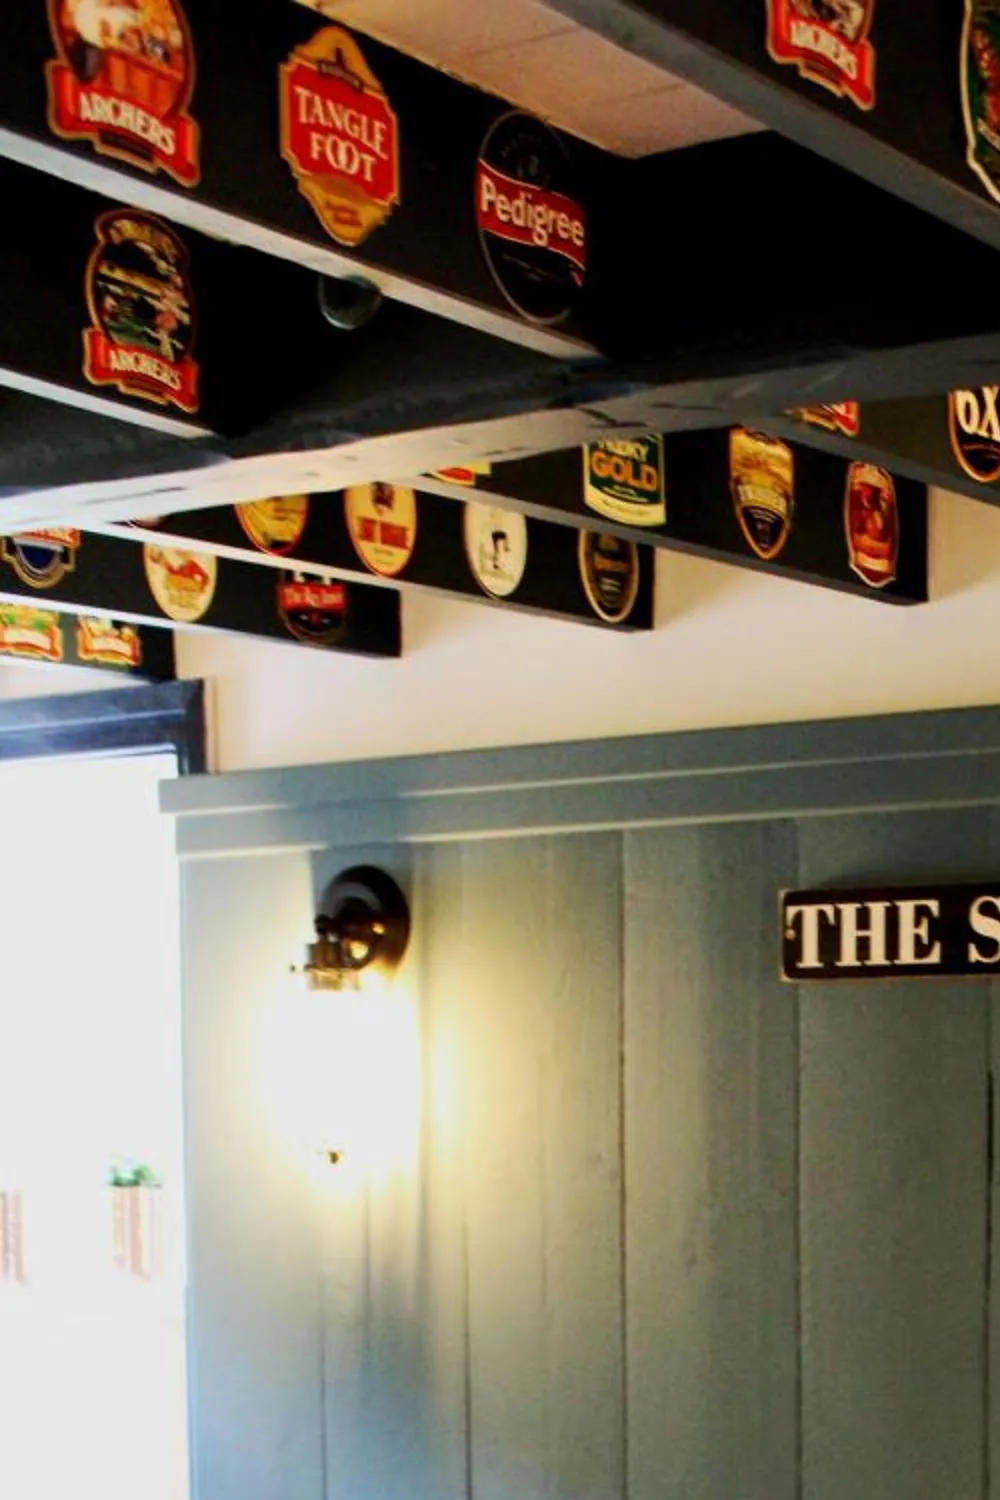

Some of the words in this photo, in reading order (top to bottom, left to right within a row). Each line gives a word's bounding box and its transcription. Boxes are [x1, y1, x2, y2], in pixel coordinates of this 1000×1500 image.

[79, 91, 176, 156] ARCHERS
[294, 86, 389, 161] TANGLE
[310, 131, 377, 182] FOOT
[479, 173, 586, 247] Pedigree
[591, 449, 659, 492] GOLD
[786, 899, 942, 969] THE
